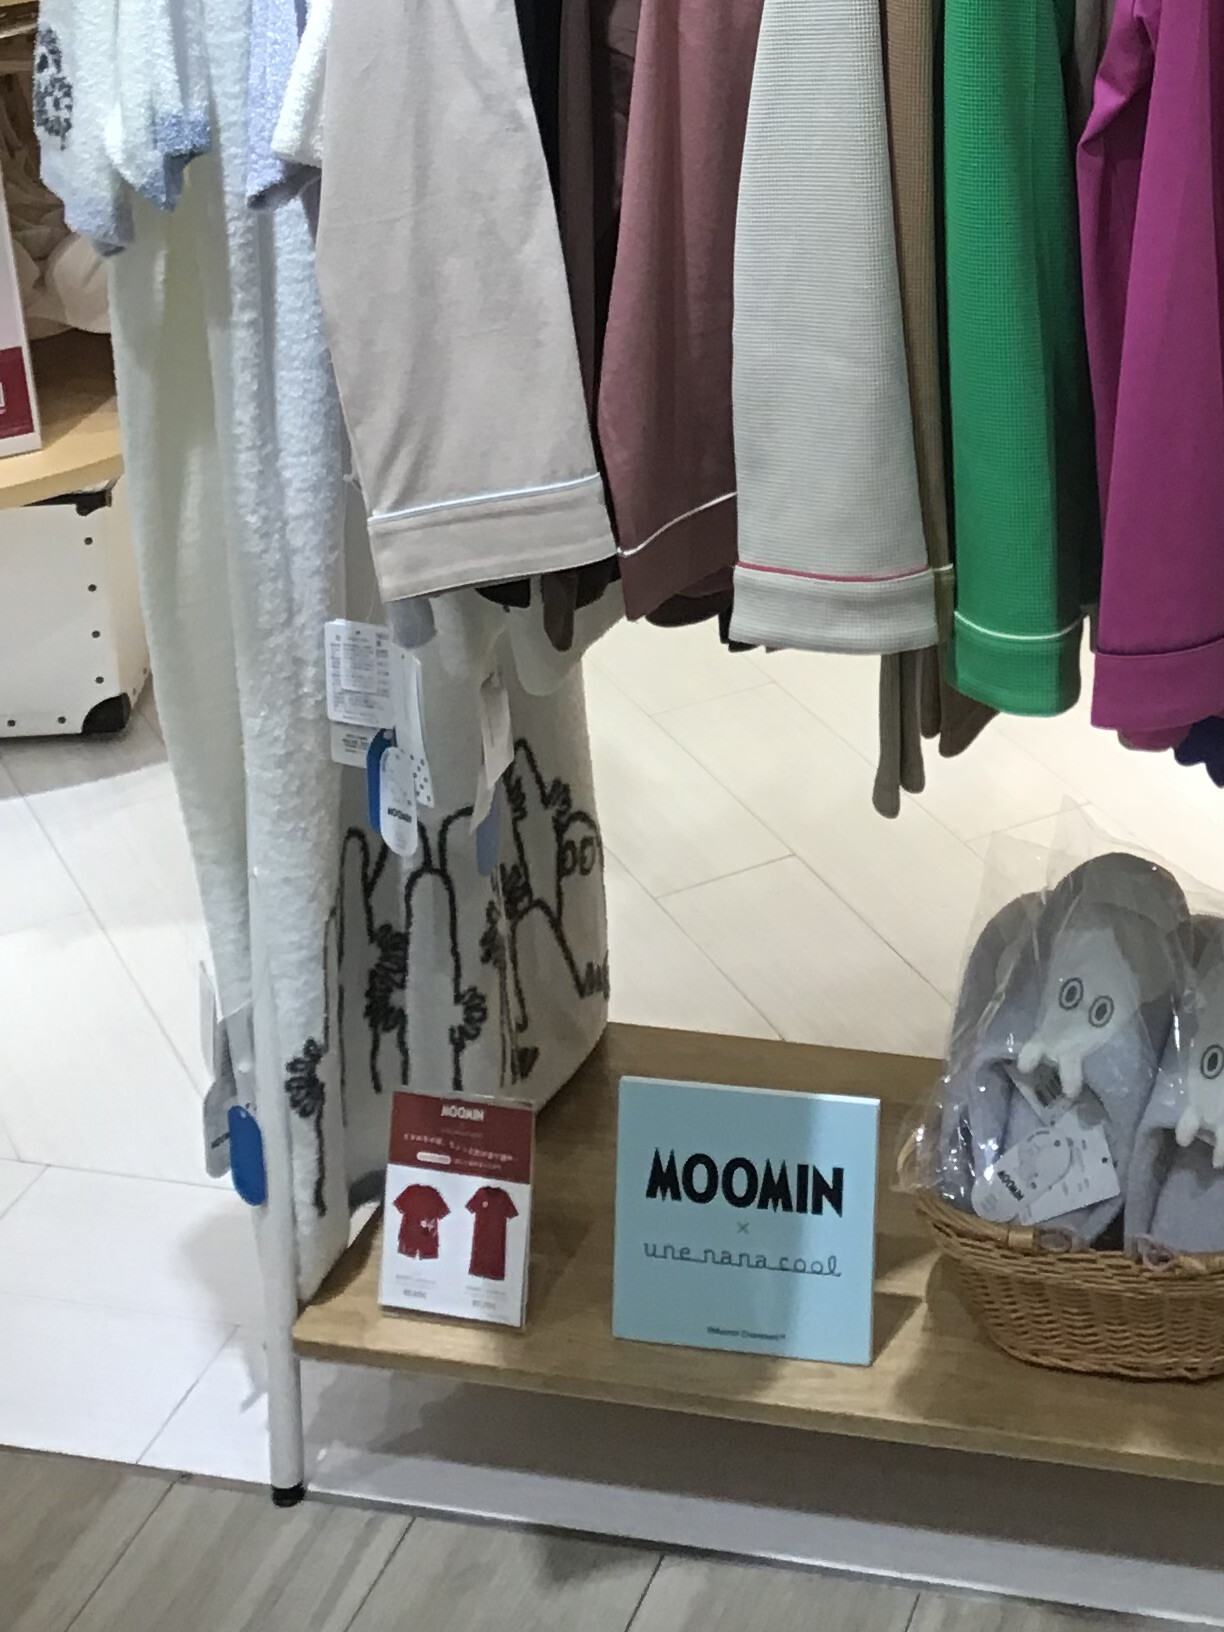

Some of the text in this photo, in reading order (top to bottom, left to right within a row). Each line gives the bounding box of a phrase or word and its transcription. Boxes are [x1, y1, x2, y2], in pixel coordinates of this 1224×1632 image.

[646, 1146, 844, 1218] MOOMIN
[643, 1242, 843, 1278] une nana cool
